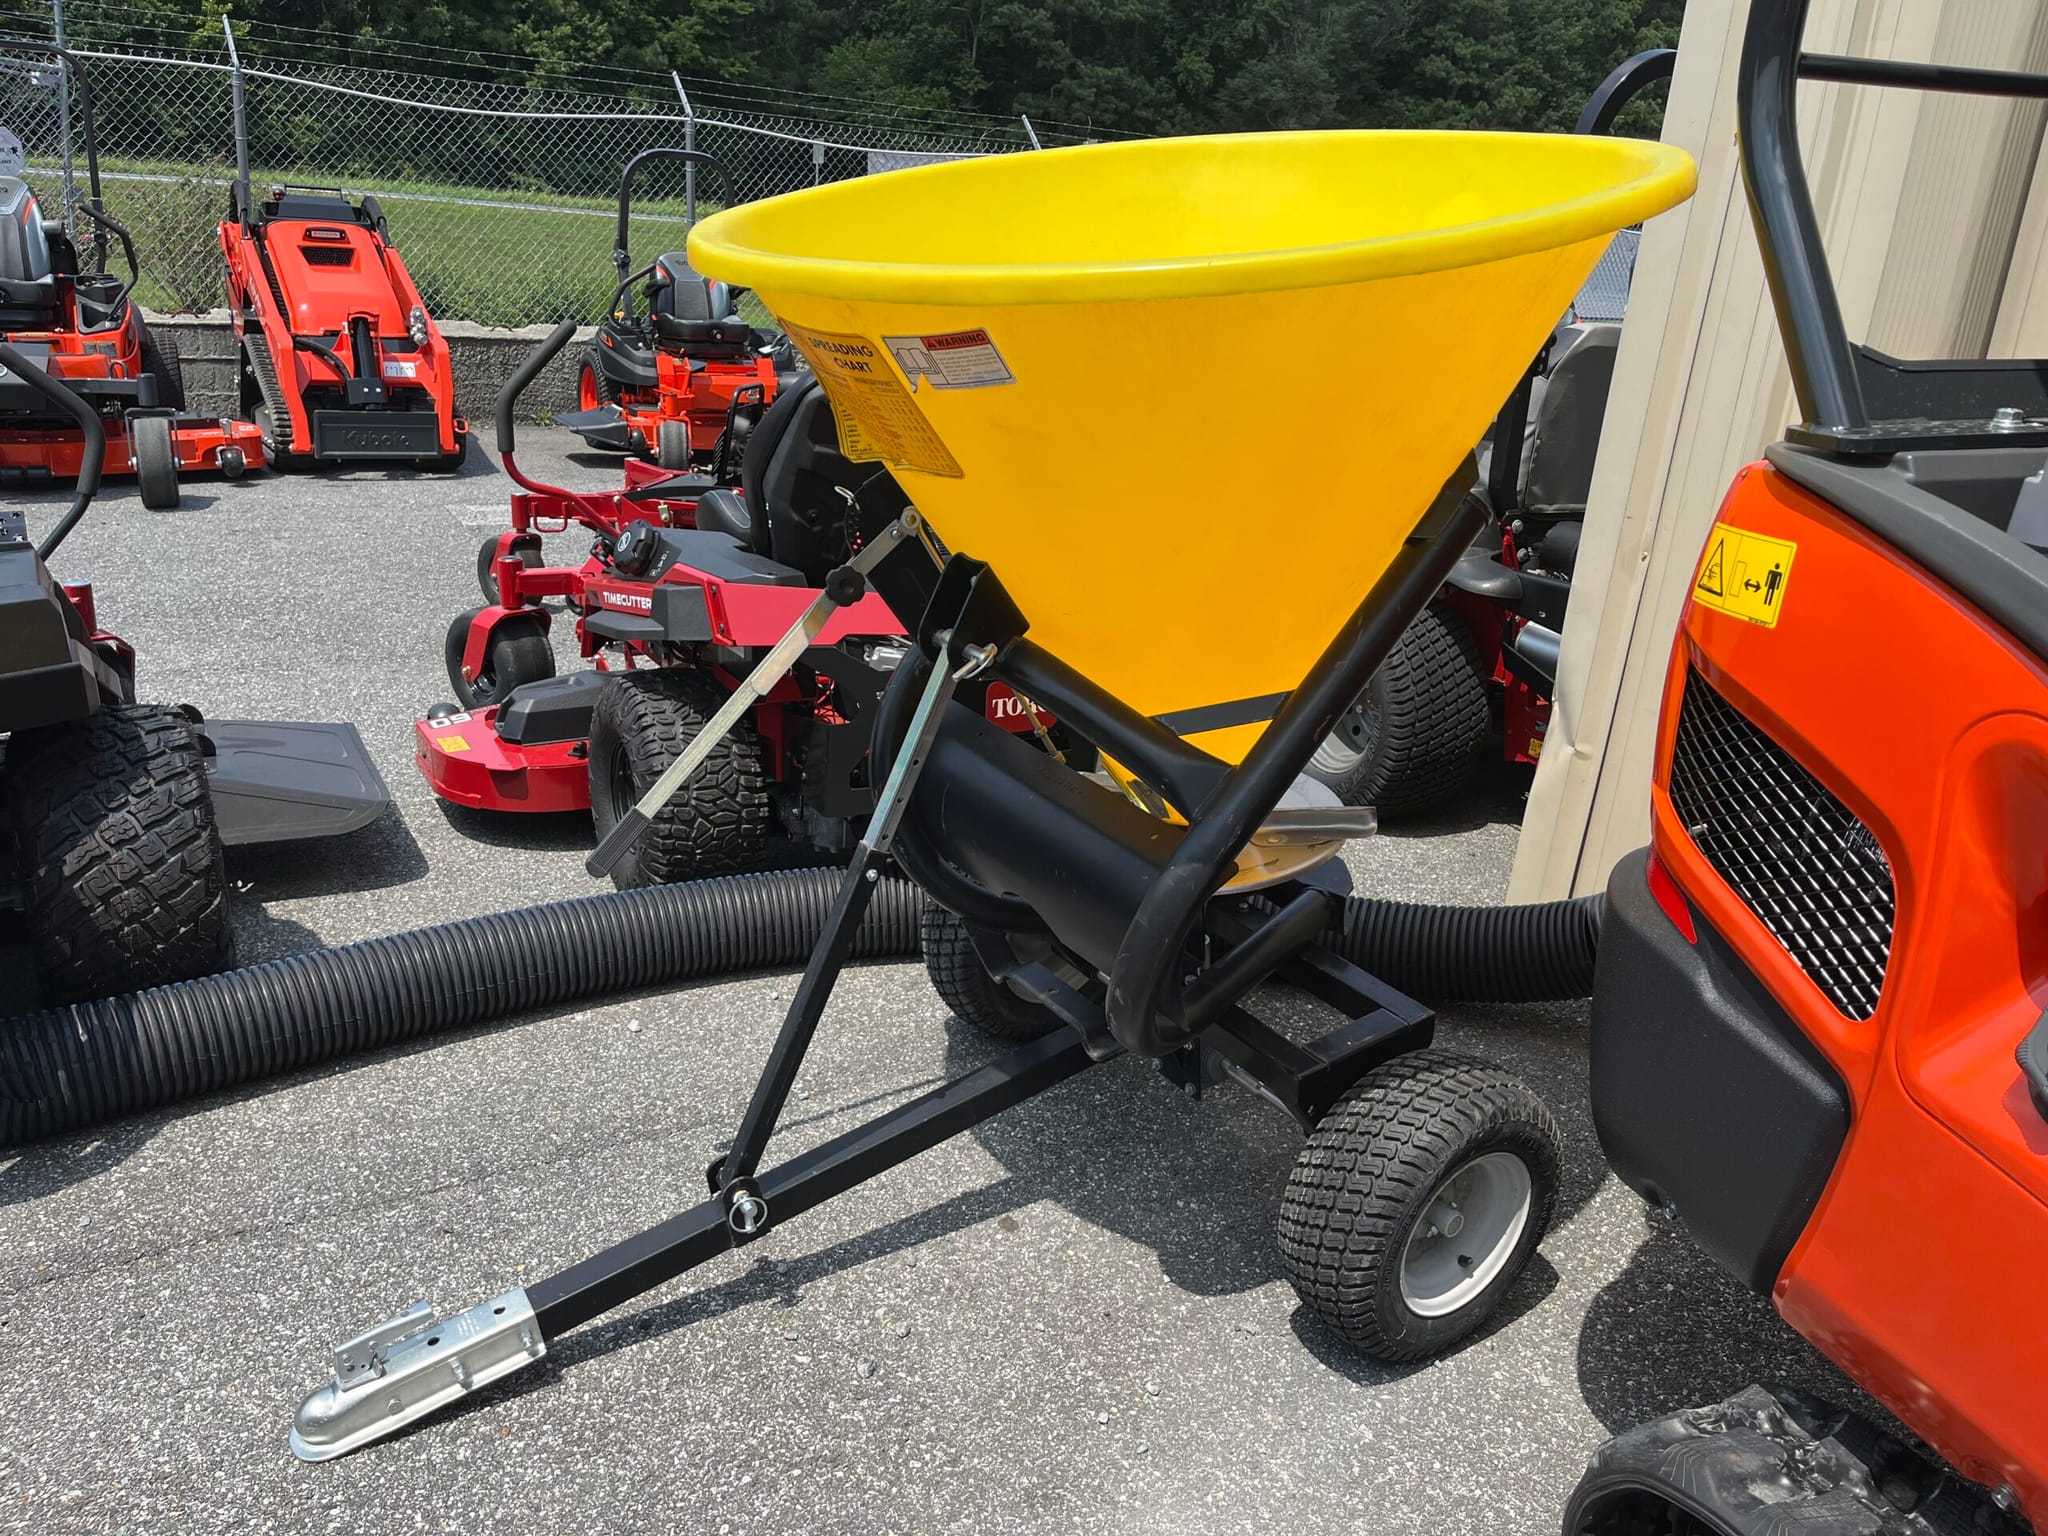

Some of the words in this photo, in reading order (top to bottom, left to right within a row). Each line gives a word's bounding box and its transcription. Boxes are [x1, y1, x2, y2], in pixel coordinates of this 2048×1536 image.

[808, 336, 874, 358] SPREADING
[935, 333, 985, 348] WARNING
[833, 356, 873, 373] CHART
[602, 591, 652, 609] TIMECUTTER
[992, 696, 1047, 719] TOR
